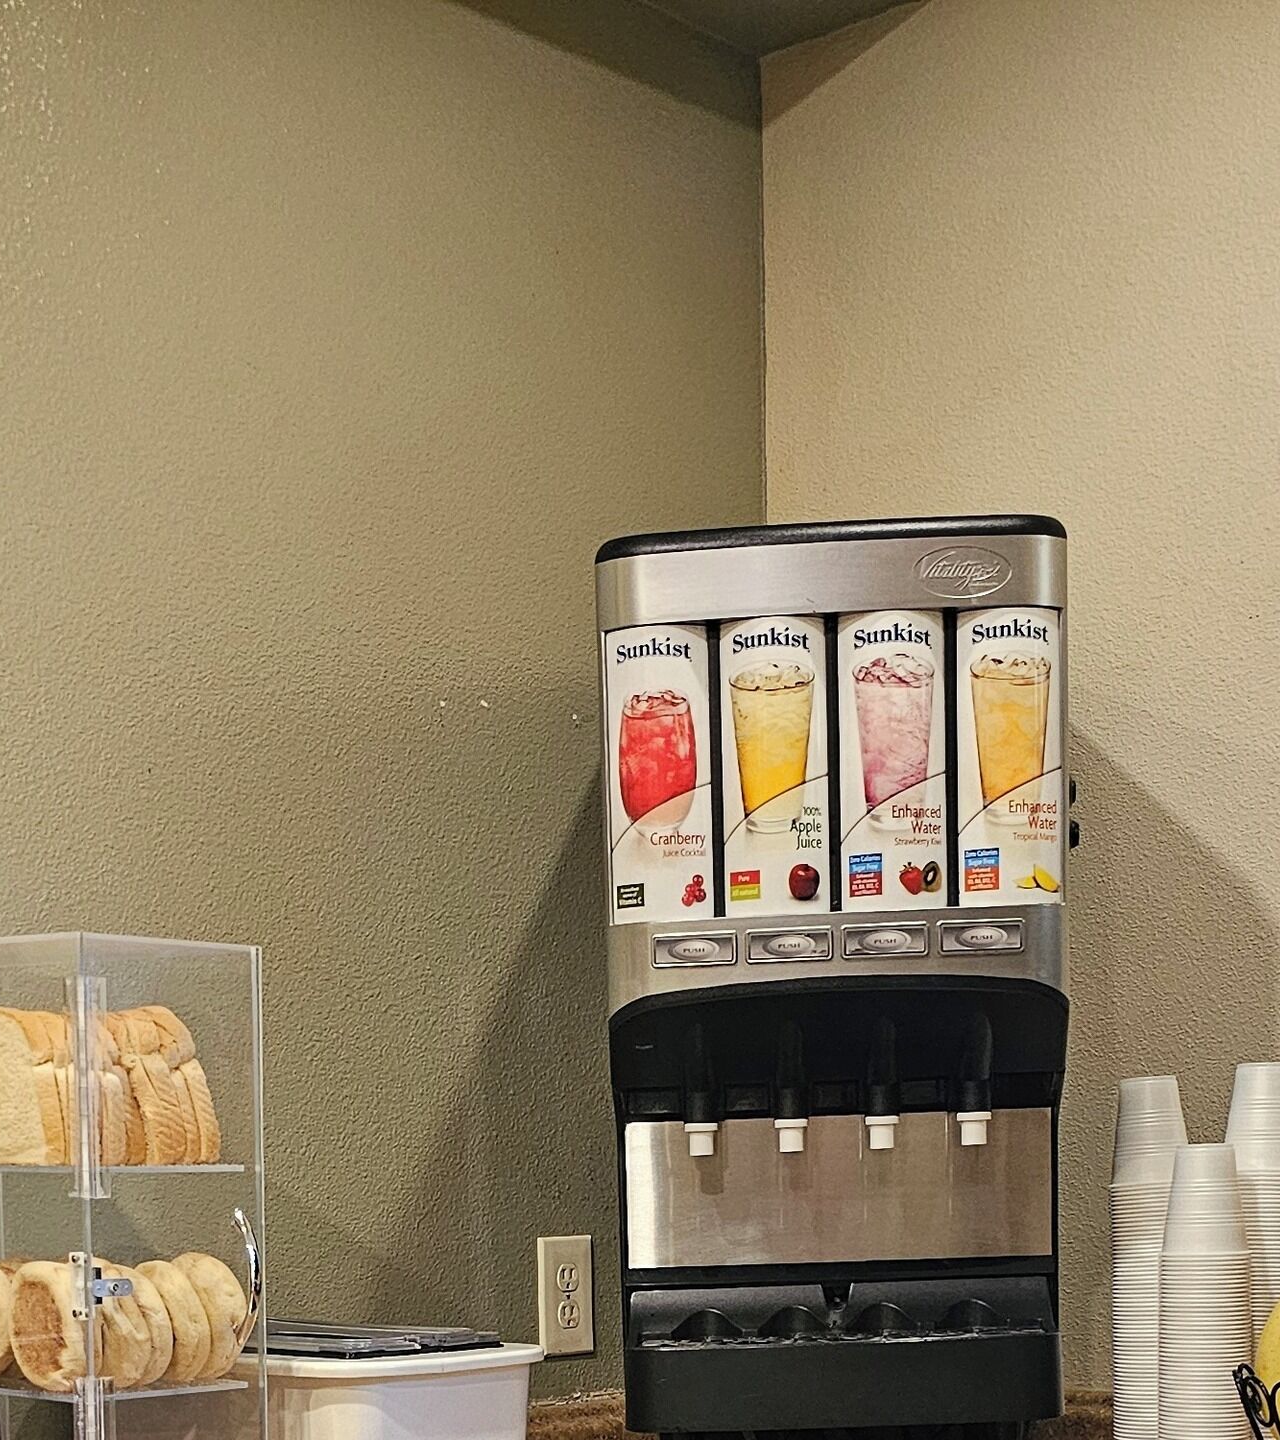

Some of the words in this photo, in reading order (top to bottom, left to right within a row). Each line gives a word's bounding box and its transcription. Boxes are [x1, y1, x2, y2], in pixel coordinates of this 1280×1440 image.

[853, 622, 932, 650] Sunkist
[972, 618, 1050, 645] Sunkist
[732, 625, 810, 655] Sunkist
[616, 635, 691, 665] Sunkist
[892, 804, 942, 818] Enhanced
[1009, 800, 1057, 814] Enhanced
[790, 819, 822, 835] Apple
[911, 821, 942, 834] Water
[1028, 816, 1057, 830] Water
[650, 833, 706, 847] Cranberry
[796, 835, 822, 850] Juice
